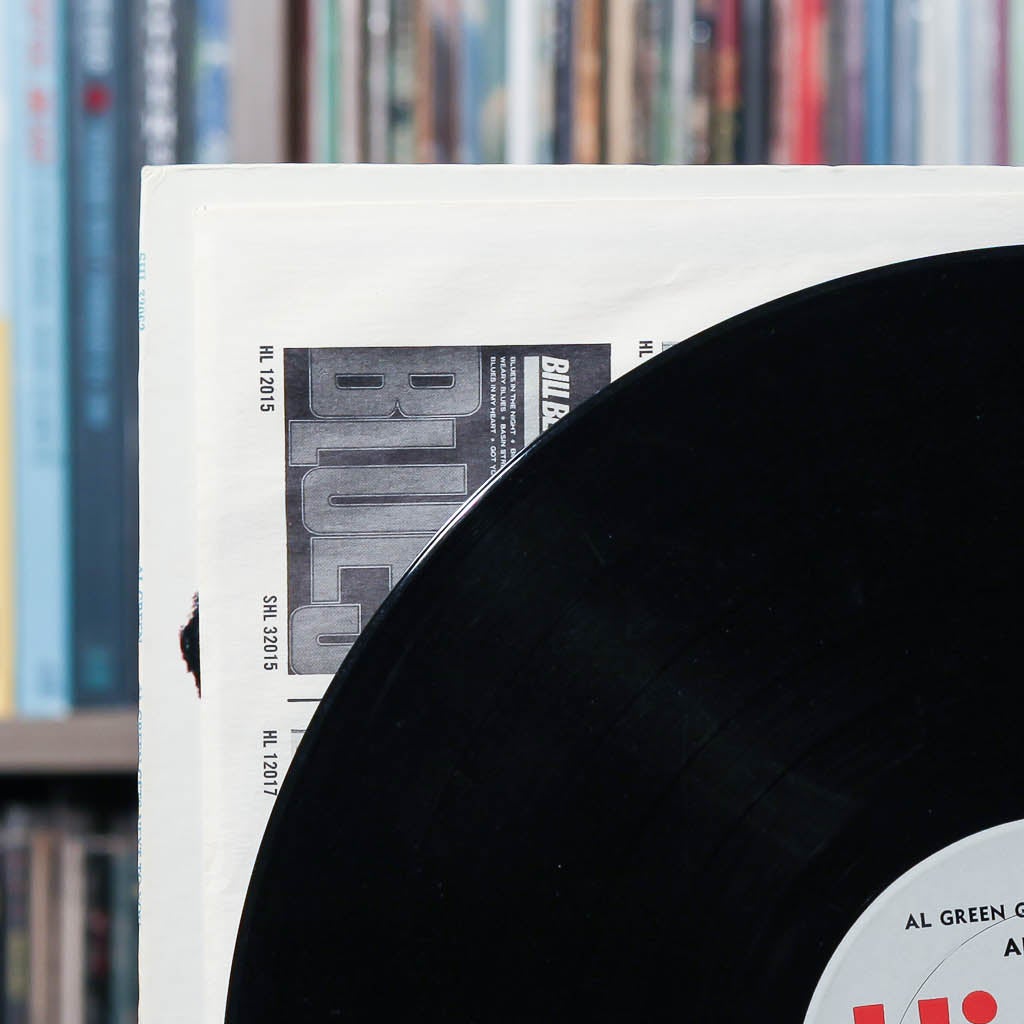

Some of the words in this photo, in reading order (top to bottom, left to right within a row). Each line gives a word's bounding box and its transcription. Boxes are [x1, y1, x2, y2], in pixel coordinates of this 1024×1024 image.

[259, 345, 274, 364] HL
[639, 340, 653, 358] HL
[509, 356, 517, 383] BLUES
[541, 355, 570, 399] BILL
[259, 372, 275, 413] 12015
[490, 384, 497, 393] IN
[490, 393, 497, 406] MY
[509, 383, 517, 392] IN
[509, 393, 517, 410] THE
[509, 411, 517, 436] NIGHT
[263, 595, 277, 622] SHL
[263, 626, 278, 671] 32015
[263, 730, 277, 748] HL
[263, 753, 278, 796] 12017
[905, 912, 932, 930] AL
[939, 904, 1006, 926] GREEN
